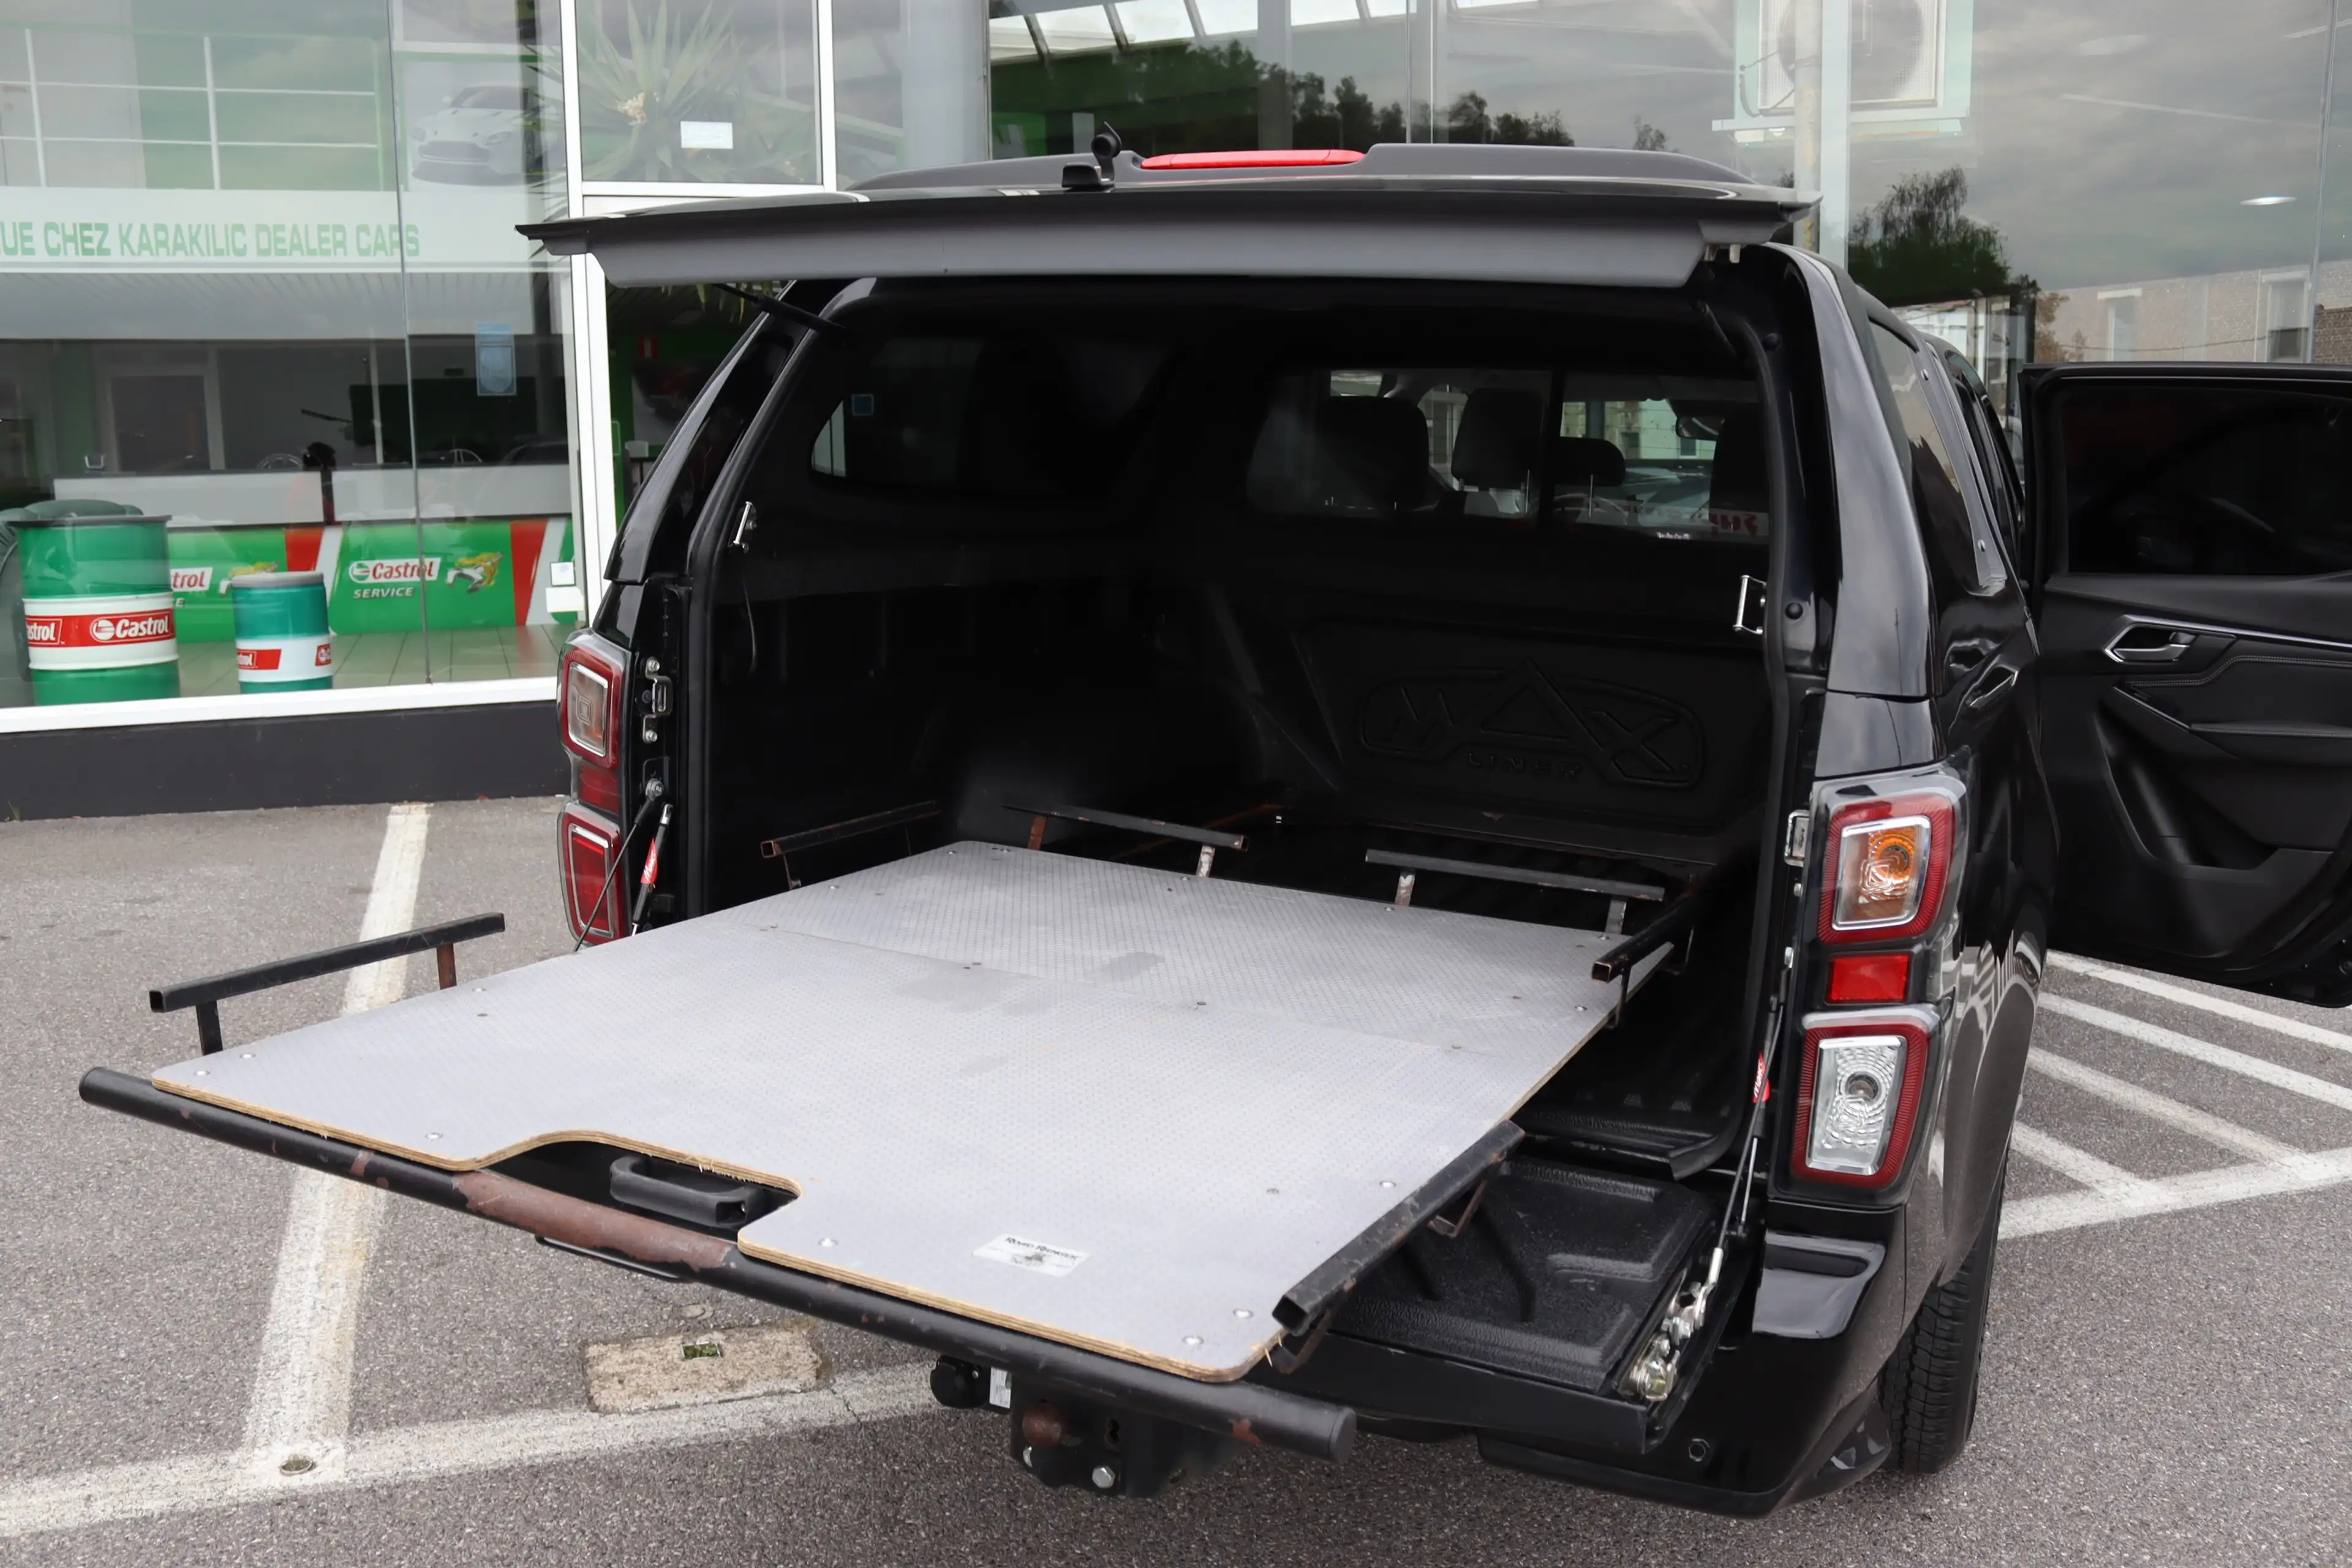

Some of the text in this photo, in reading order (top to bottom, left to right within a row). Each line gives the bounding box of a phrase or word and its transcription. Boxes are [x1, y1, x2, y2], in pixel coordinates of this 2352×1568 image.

[43, 222, 111, 256] CHEZ
[118, 223, 247, 257] KARAKILIC
[255, 224, 347, 257] DEALER
[372, 561, 434, 579] Castrol
[353, 587, 413, 599] SERVICE
[116, 615, 169, 638] Castrol
